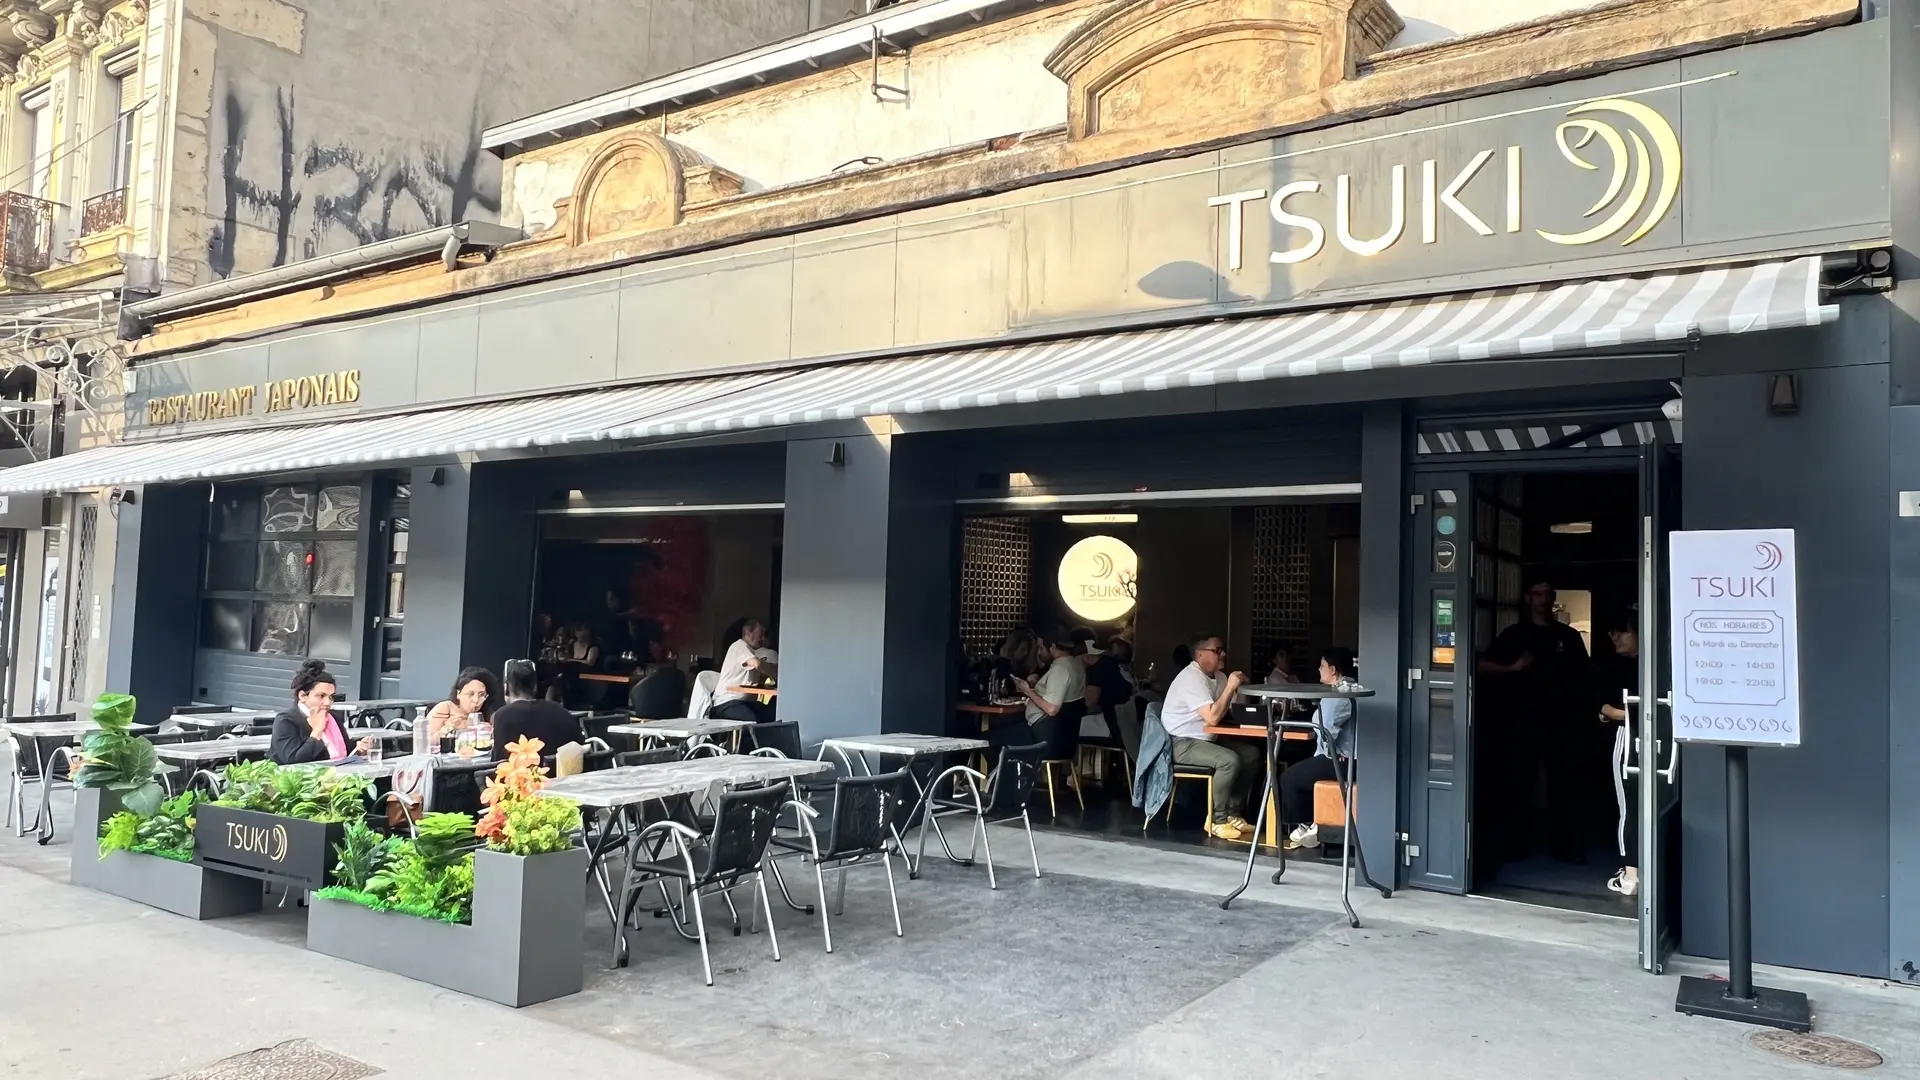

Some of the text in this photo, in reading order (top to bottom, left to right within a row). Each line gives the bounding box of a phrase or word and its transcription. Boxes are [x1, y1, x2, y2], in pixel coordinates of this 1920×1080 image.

[1207, 144, 1522, 272] TSUKI
[148, 369, 360, 426] RESTAURANT JAPONAIS
[1080, 584, 1121, 597] TSUKI
[1690, 576, 1776, 598] TSUKI
[1723, 622, 1767, 630] HORAIRES
[1689, 640, 1700, 648] Du
[1740, 641, 1779, 649] Dimanche
[226, 822, 269, 855] TSUKI
